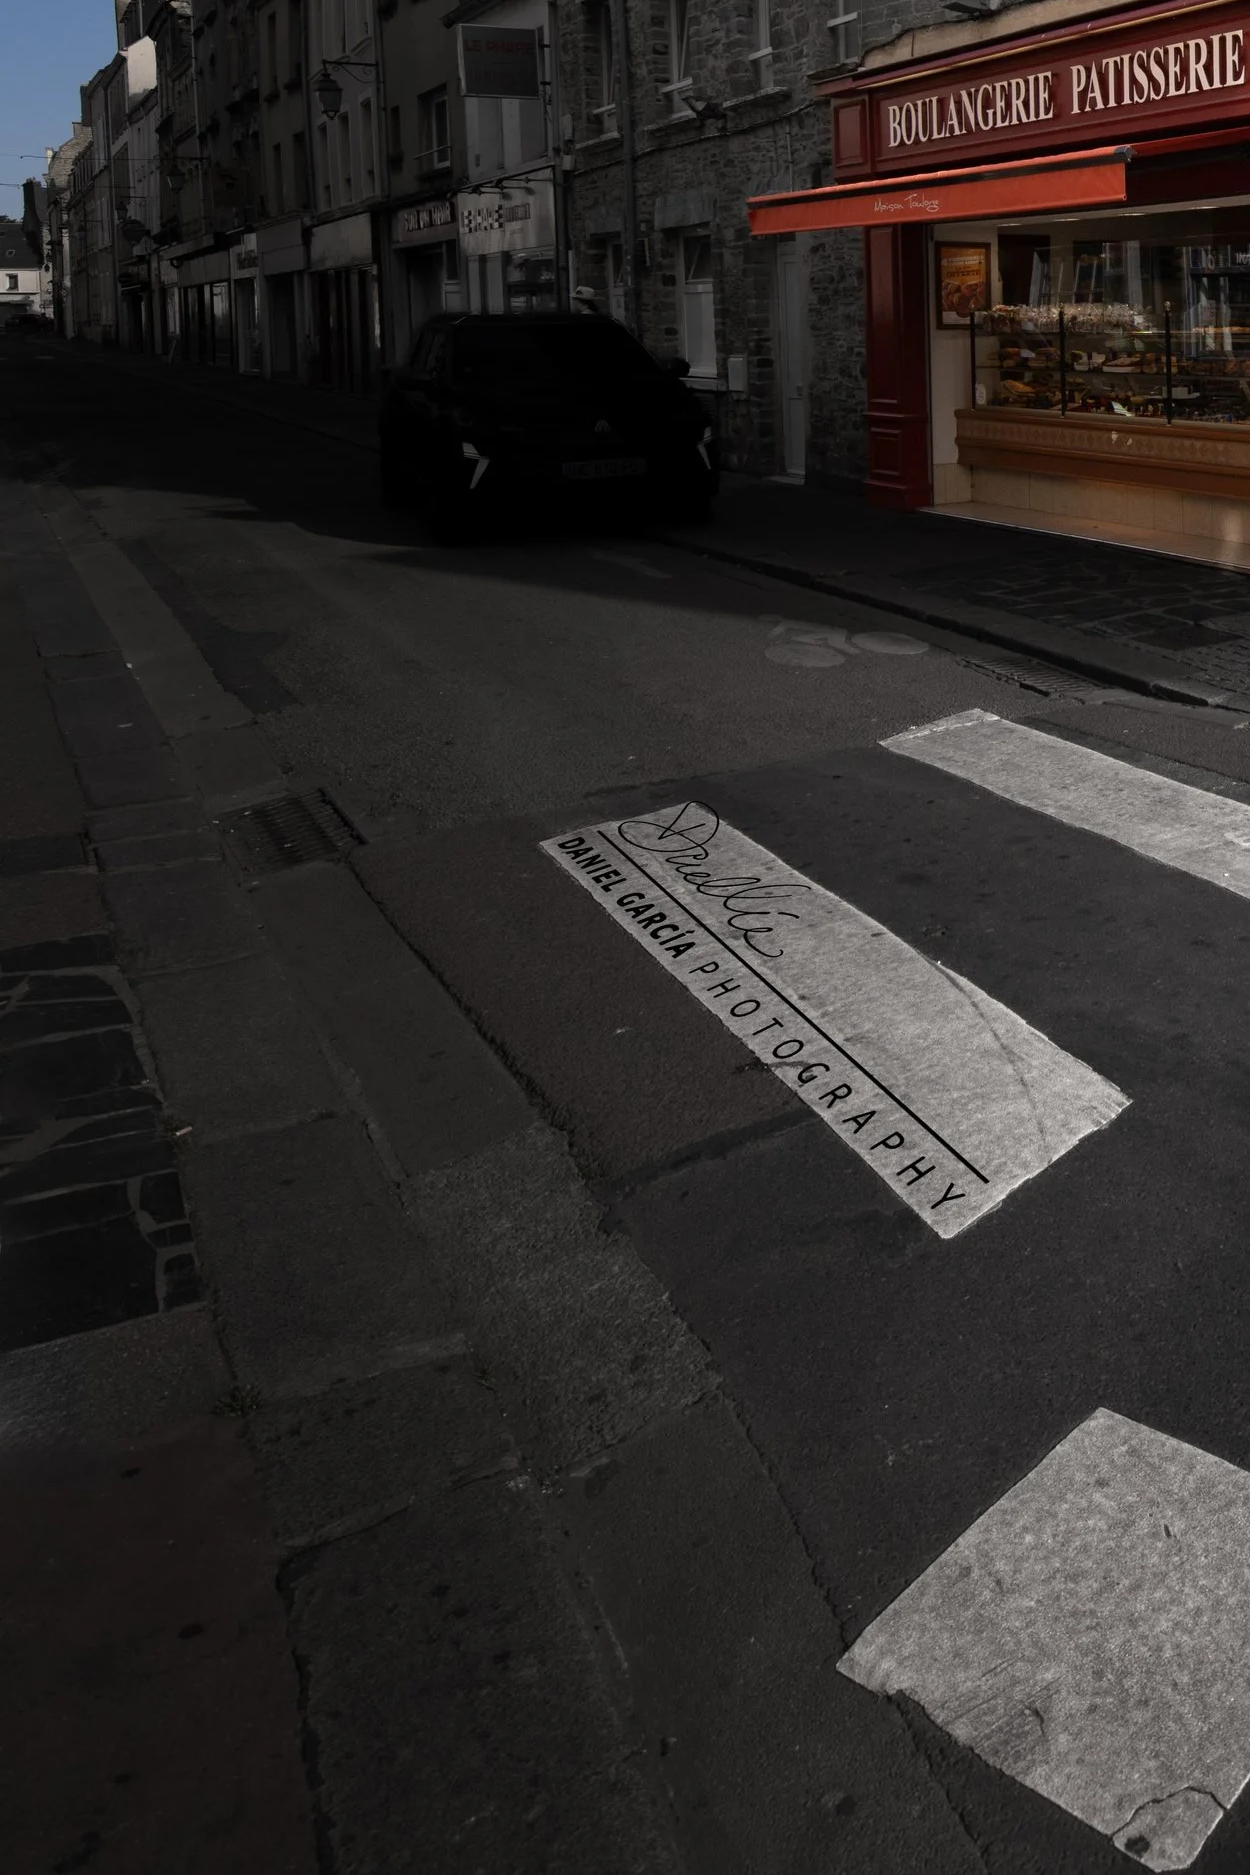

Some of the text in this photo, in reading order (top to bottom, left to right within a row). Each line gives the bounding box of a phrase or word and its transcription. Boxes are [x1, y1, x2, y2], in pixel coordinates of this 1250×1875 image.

[888, 29, 1246, 147] BOULANGERIE PATISSERIE
[874, 197, 904, 213] Maison
